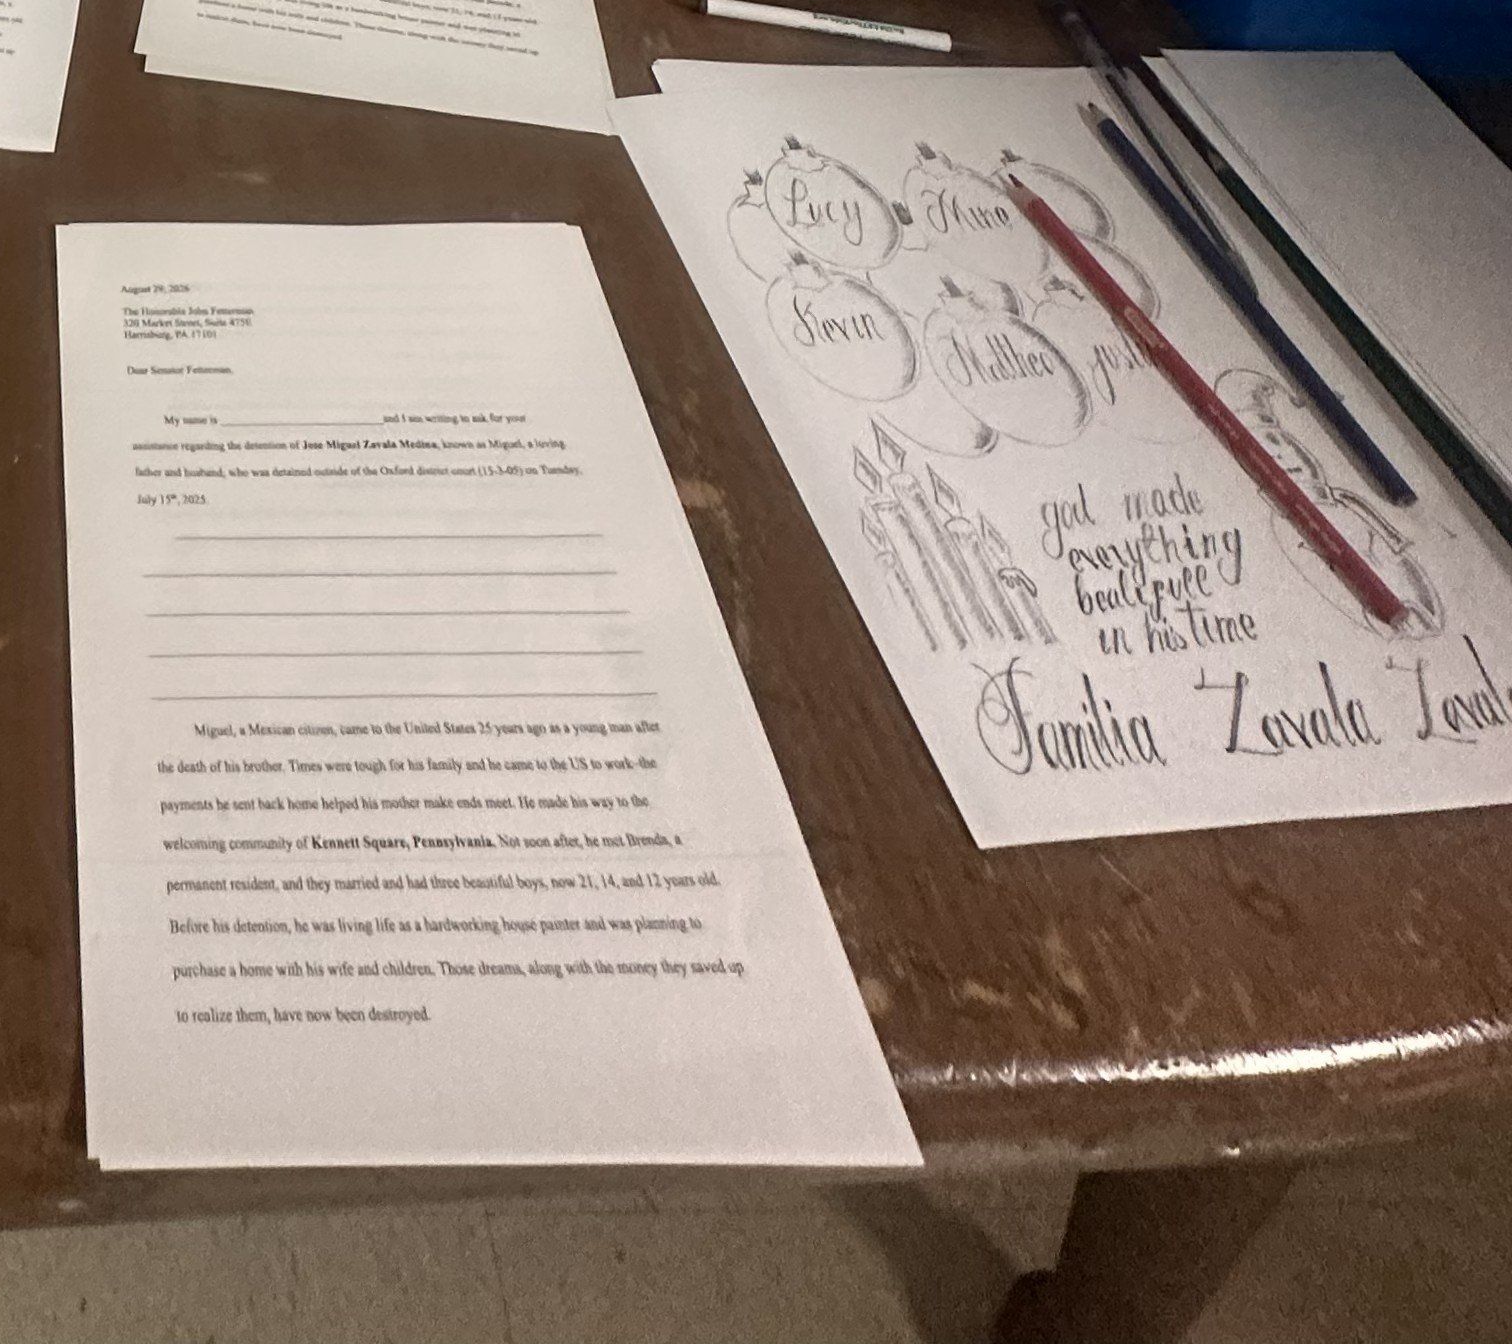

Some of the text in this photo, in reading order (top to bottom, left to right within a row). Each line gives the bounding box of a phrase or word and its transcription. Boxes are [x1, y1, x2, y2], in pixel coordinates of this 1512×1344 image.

[786, 177, 863, 246] Lucy
[792, 294, 888, 347] Kevin
[1125, 472, 1203, 521] made
[1069, 522, 1242, 587] everything
[1098, 600, 1258, 655] in his time
[970, 656, 1167, 776] Familia
[1385, 634, 1511, 745] Zaval
